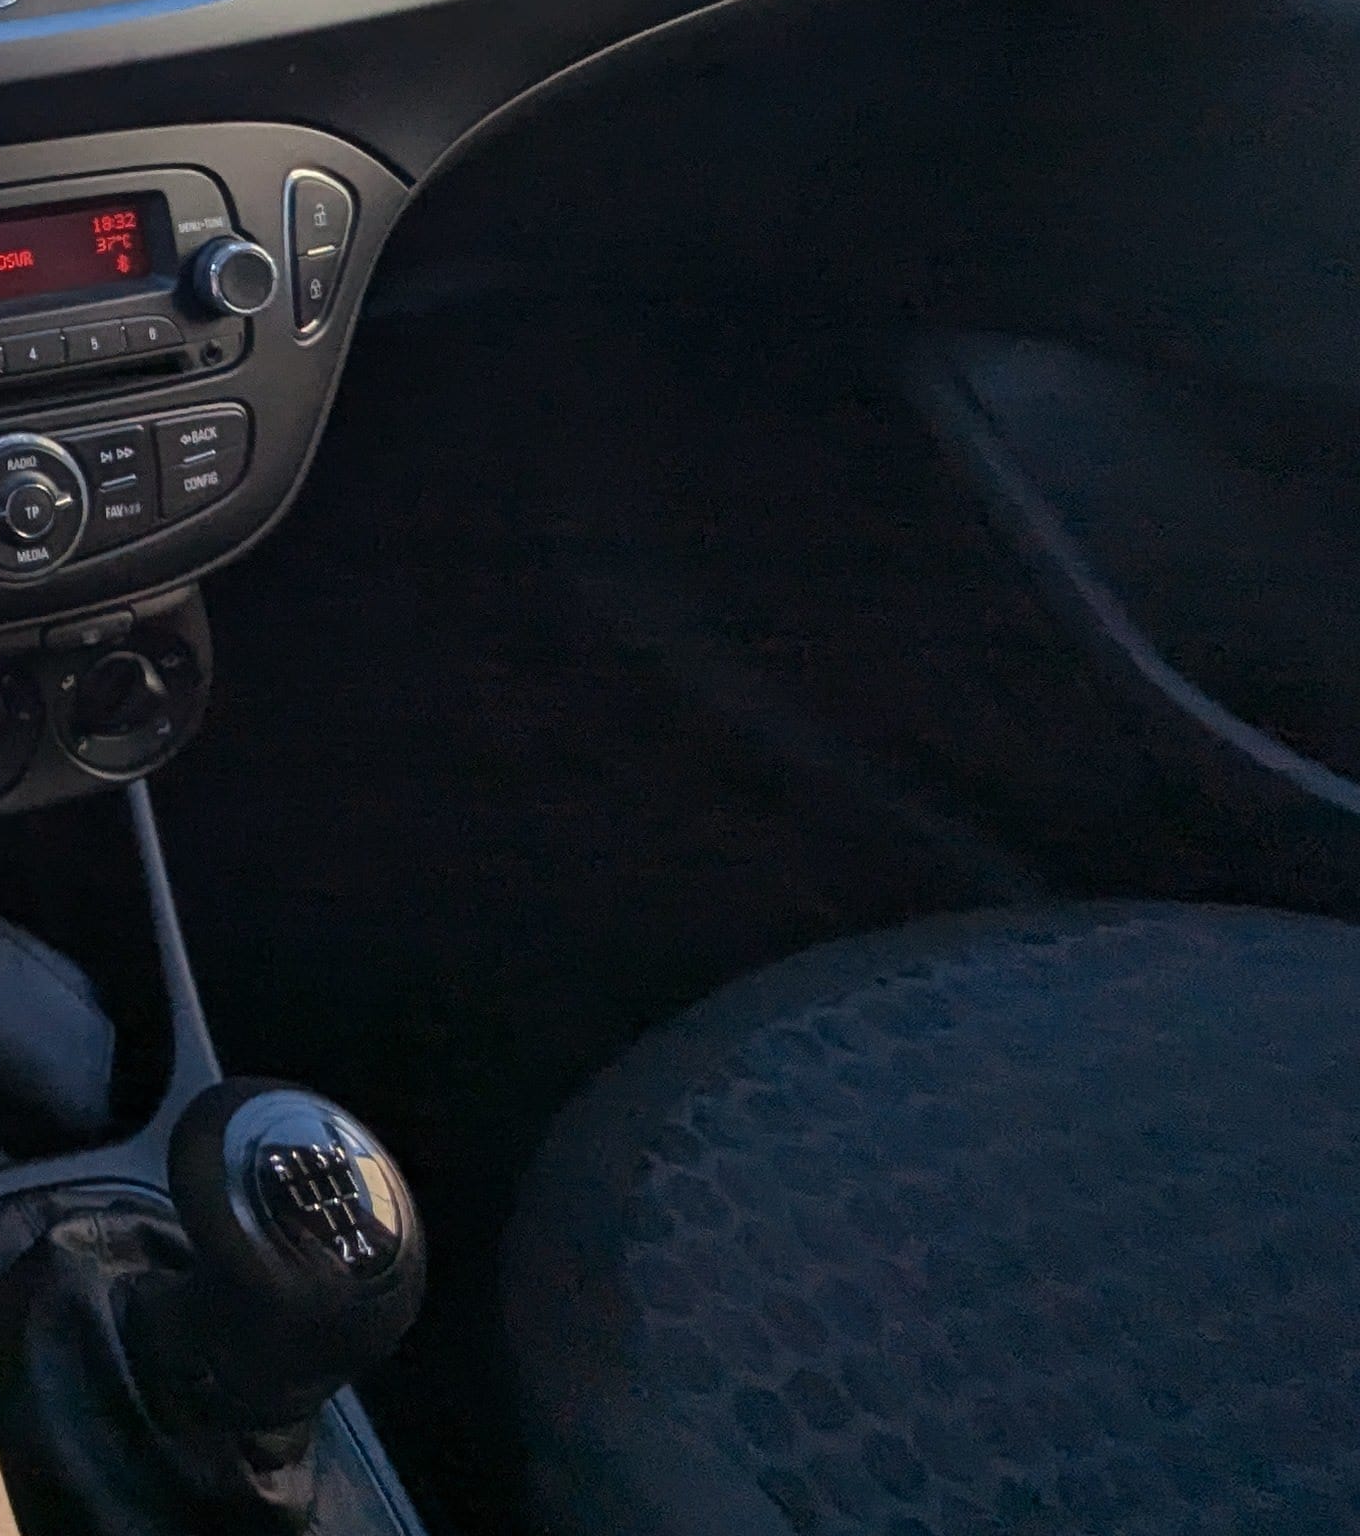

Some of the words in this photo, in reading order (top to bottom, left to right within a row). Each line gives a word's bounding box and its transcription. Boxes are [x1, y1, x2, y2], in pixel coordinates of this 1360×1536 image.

[93, 213, 136, 233] 18:32
[148, 326, 157, 340] 6
[90, 337, 99, 351] 5
[29, 347, 38, 361] 4
[192, 426, 219, 444] BACK
[7, 455, 38, 471] RADIO
[184, 472, 219, 491] CONFIG
[24, 505, 40, 521] TP
[17, 548, 50, 564] MEDIA
[335, 1235, 356, 1264] 2
[356, 1229, 376, 1258] 4
